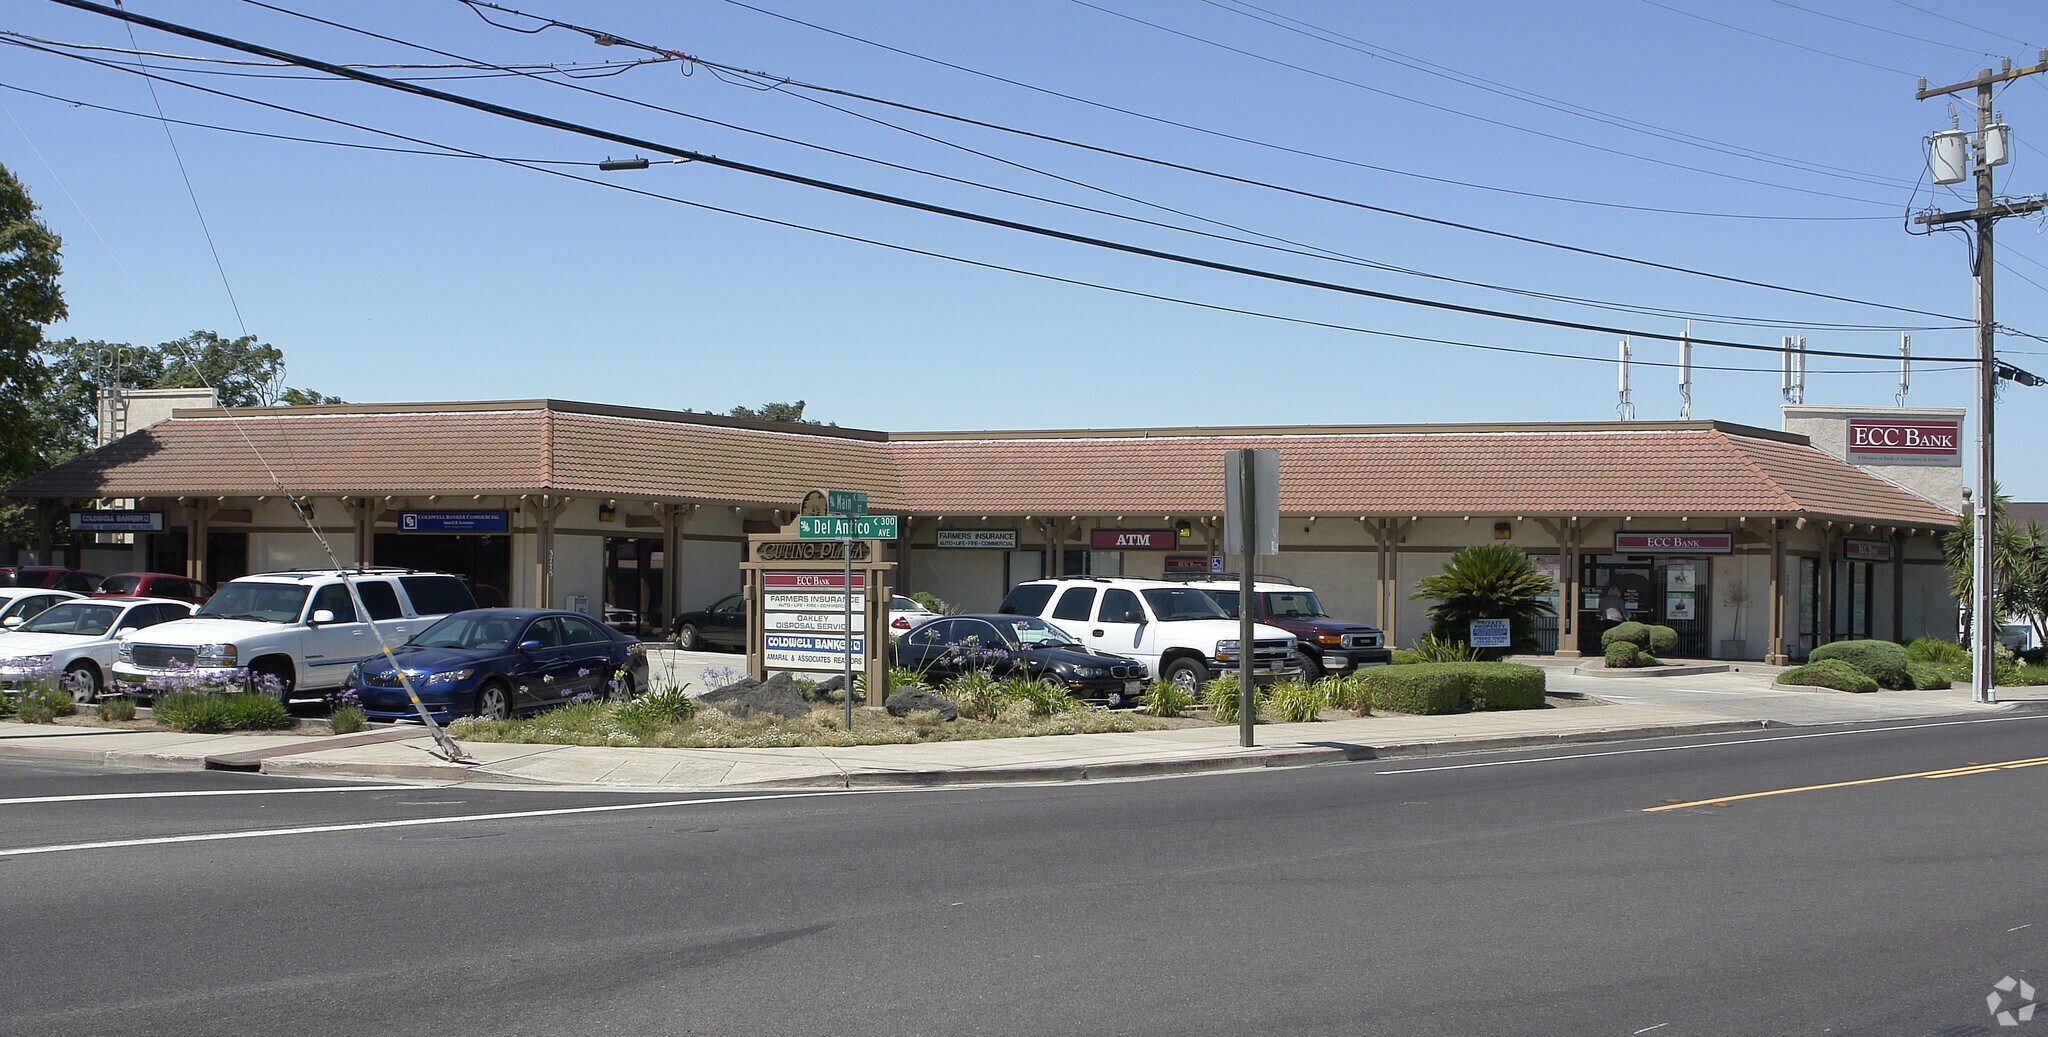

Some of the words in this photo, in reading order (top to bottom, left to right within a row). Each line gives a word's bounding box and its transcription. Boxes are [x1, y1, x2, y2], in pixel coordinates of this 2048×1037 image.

[1854, 427, 1899, 446] ECC
[836, 494, 852, 510] Main
[814, 519, 831, 535] Del
[835, 519, 870, 535] Antico
[881, 517, 895, 526] 300
[878, 528, 891, 537] AVE
[939, 532, 972, 540] FARMERS
[1115, 534, 1151, 546] ATM
[1647, 537, 1672, 547] ECC
[764, 542, 815, 560] CUTINO
[796, 576, 812, 586] ECC
[770, 595, 809, 603] FARMERS
[776, 622, 815, 630] DISPOSAL
[768, 636, 813, 649] COLDWELL
[815, 638, 853, 651] BANKE
[767, 653, 789, 661] AMARAL
[797, 655, 831, 664] ASSOCIATES
[833, 657, 862, 665] REAORS
